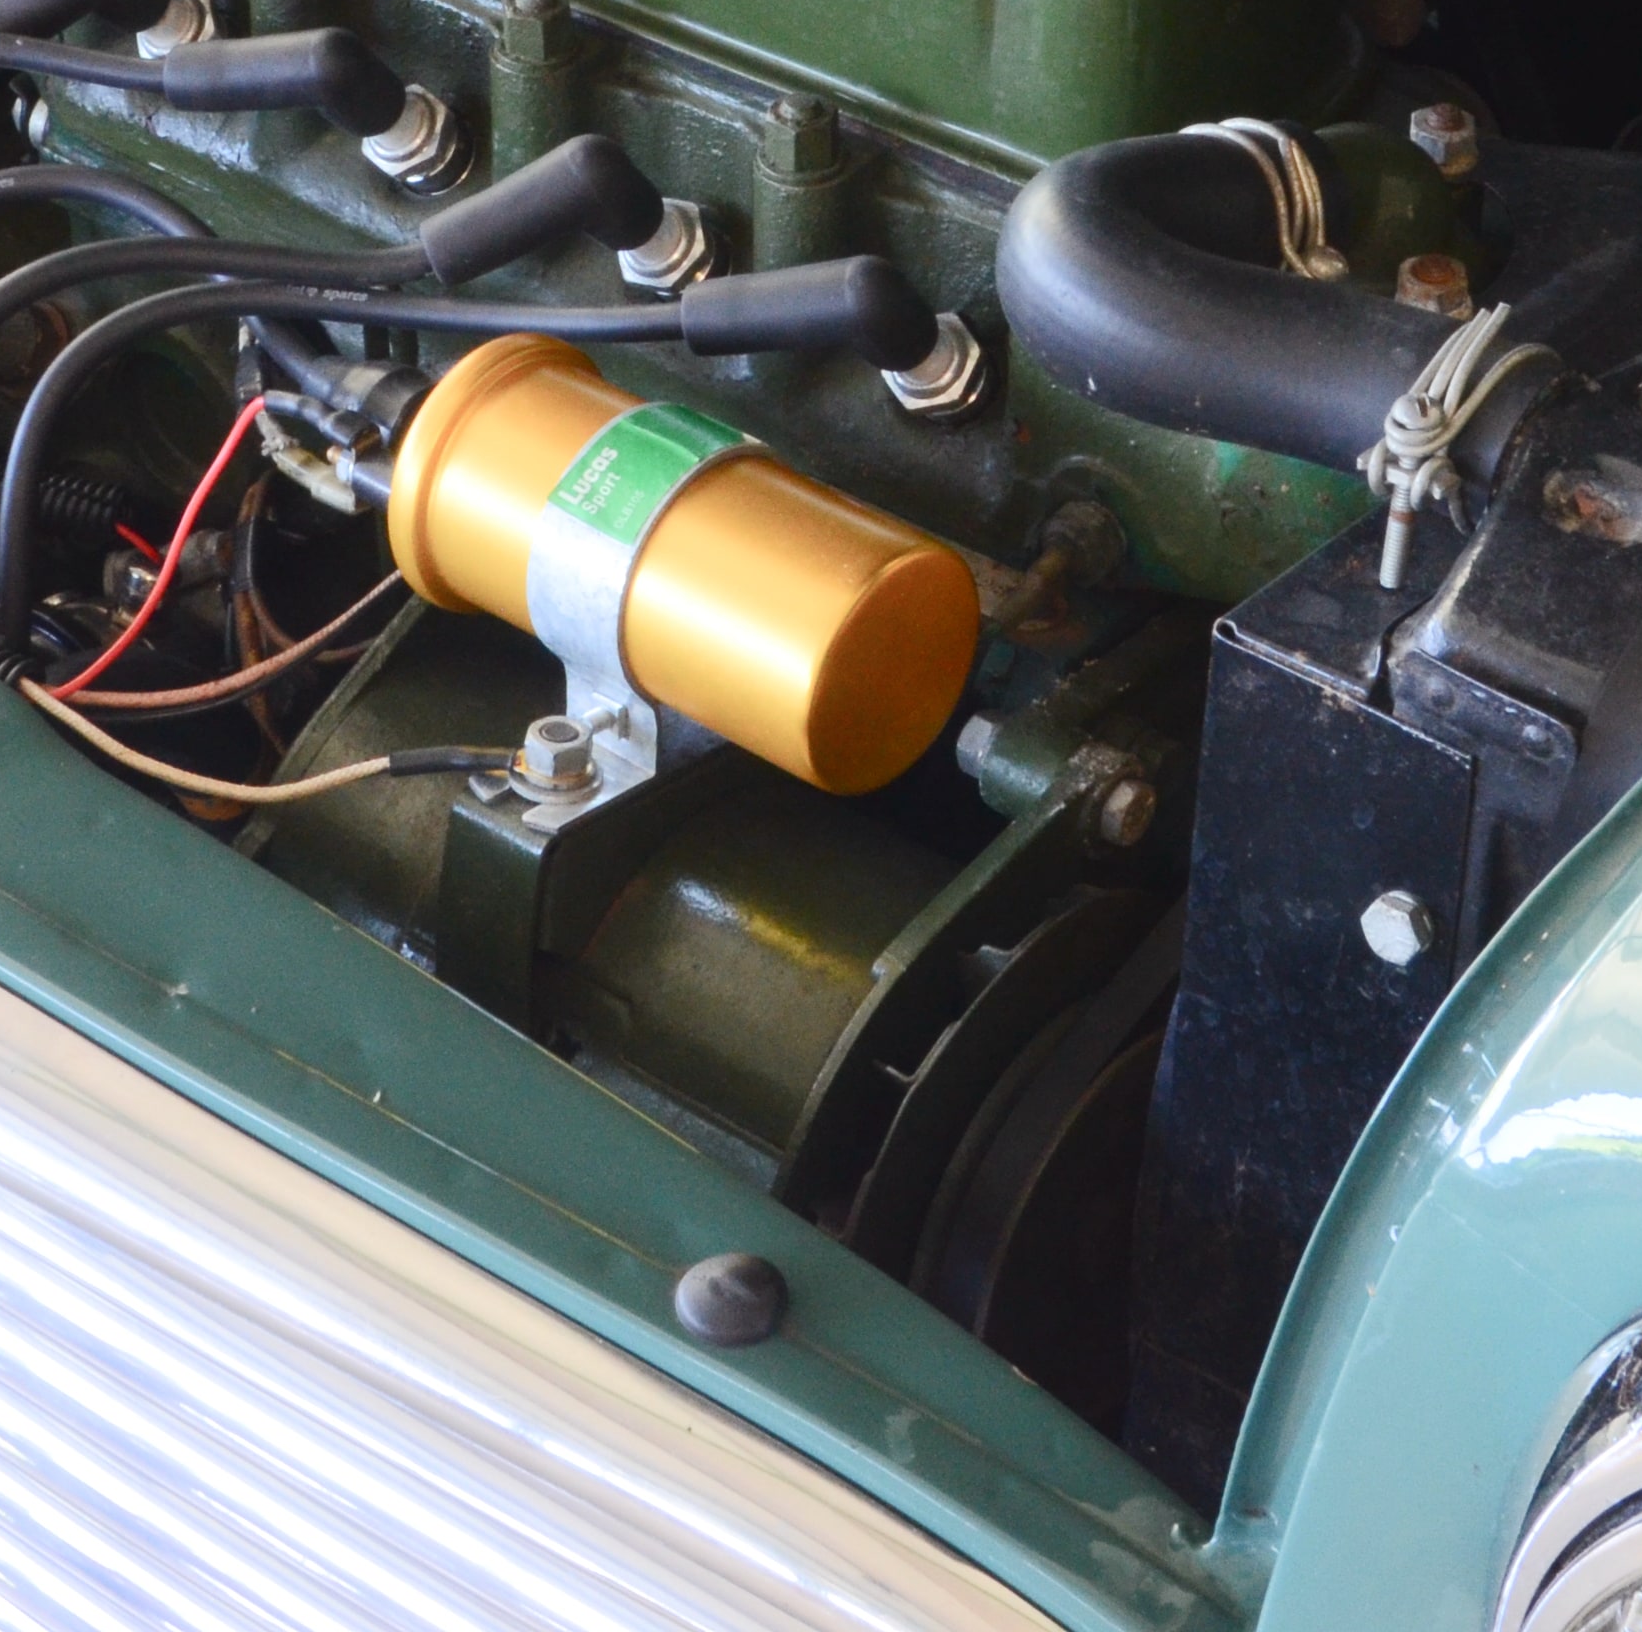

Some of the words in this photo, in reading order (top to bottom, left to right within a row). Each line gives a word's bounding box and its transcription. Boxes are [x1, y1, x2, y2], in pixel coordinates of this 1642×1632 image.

[322, 288, 368, 302] spares
[558, 446, 618, 505] Lucas
[581, 472, 622, 515] Sport
